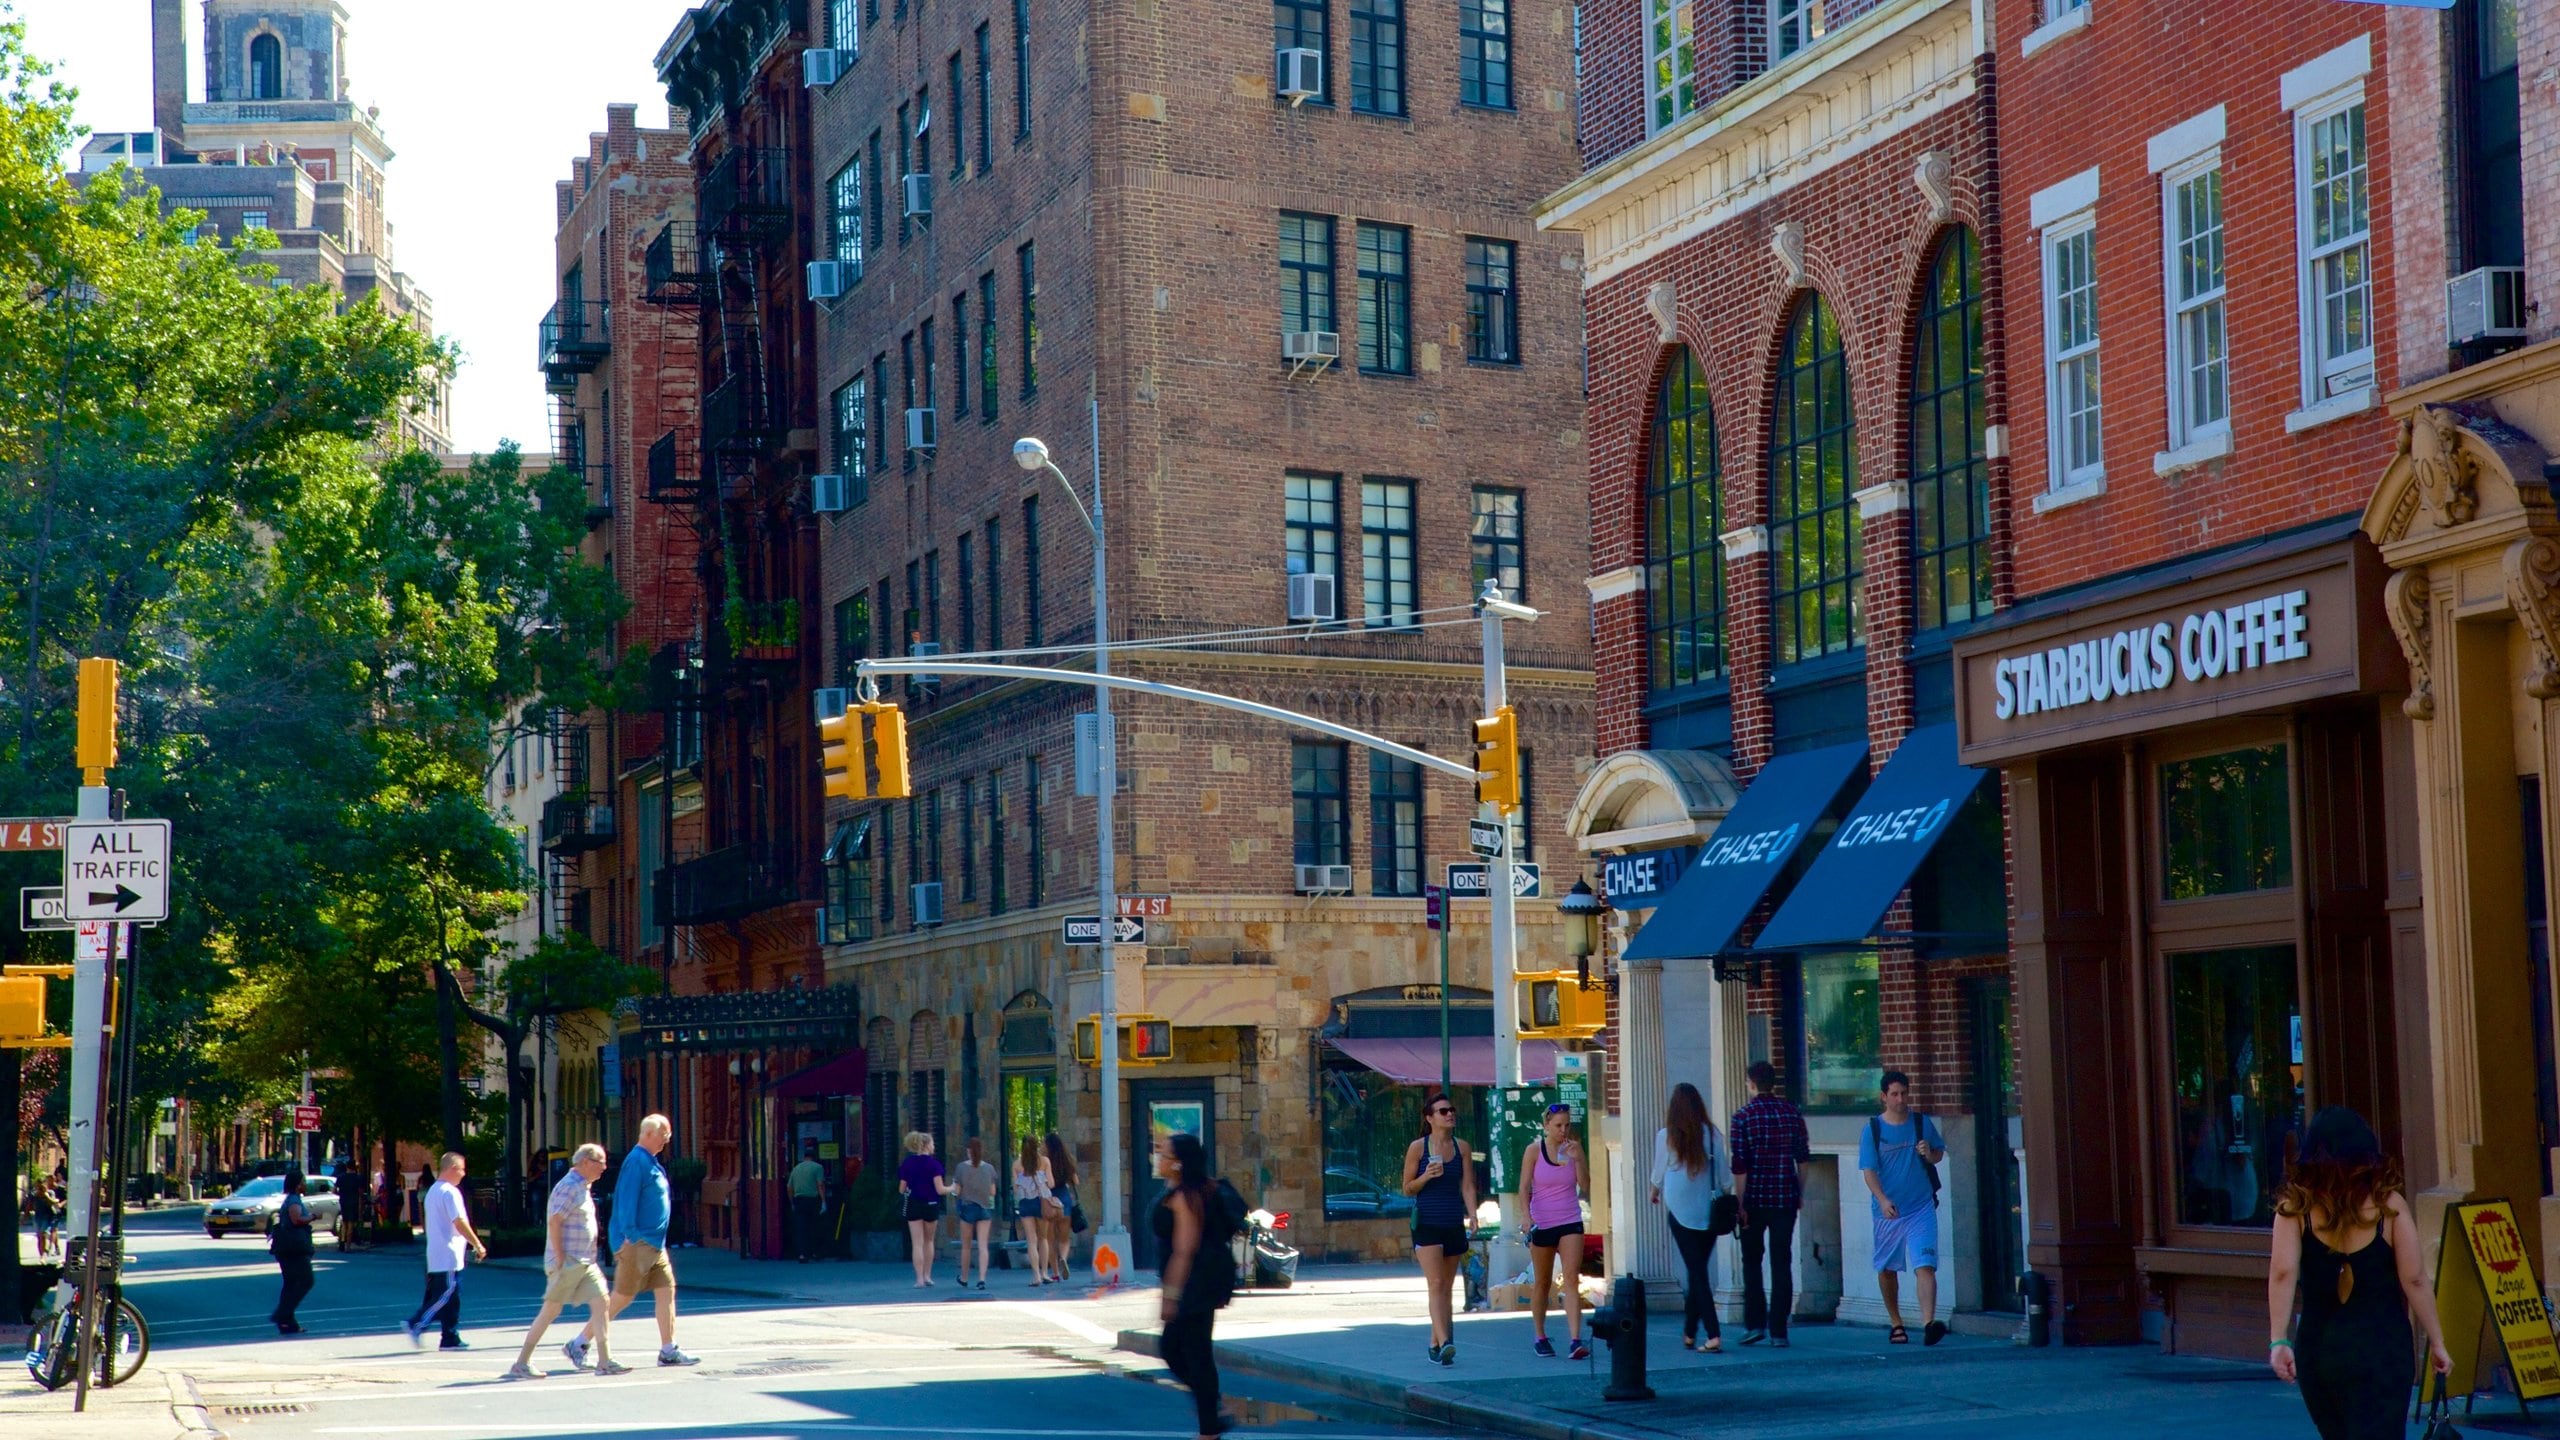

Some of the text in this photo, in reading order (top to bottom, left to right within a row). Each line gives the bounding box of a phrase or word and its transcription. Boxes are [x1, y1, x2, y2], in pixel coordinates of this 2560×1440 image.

[1995, 589, 2309, 720] STARBUCKS COFFEE
[17, 824, 32, 847] 4
[42, 823, 65, 847] ST
[1837, 806, 1929, 849] CHASE
[90, 832, 143, 855] ALL
[1700, 830, 1778, 867] CHASE
[72, 861, 160, 879] TRAFFIC
[1456, 874, 1529, 888] ONE AY
[1605, 857, 1657, 896] CHASE
[42, 901, 63, 916] ON
[1120, 898, 1167, 914] W 4 ST
[81, 920, 97, 934] NO
[1071, 924, 1097, 936] ONE
[89, 936, 128, 945] ANYME
[2475, 1221, 2519, 1263] FREE
[2496, 1274, 2526, 1299] Large
[2495, 1298, 2544, 1327] COFFEE
